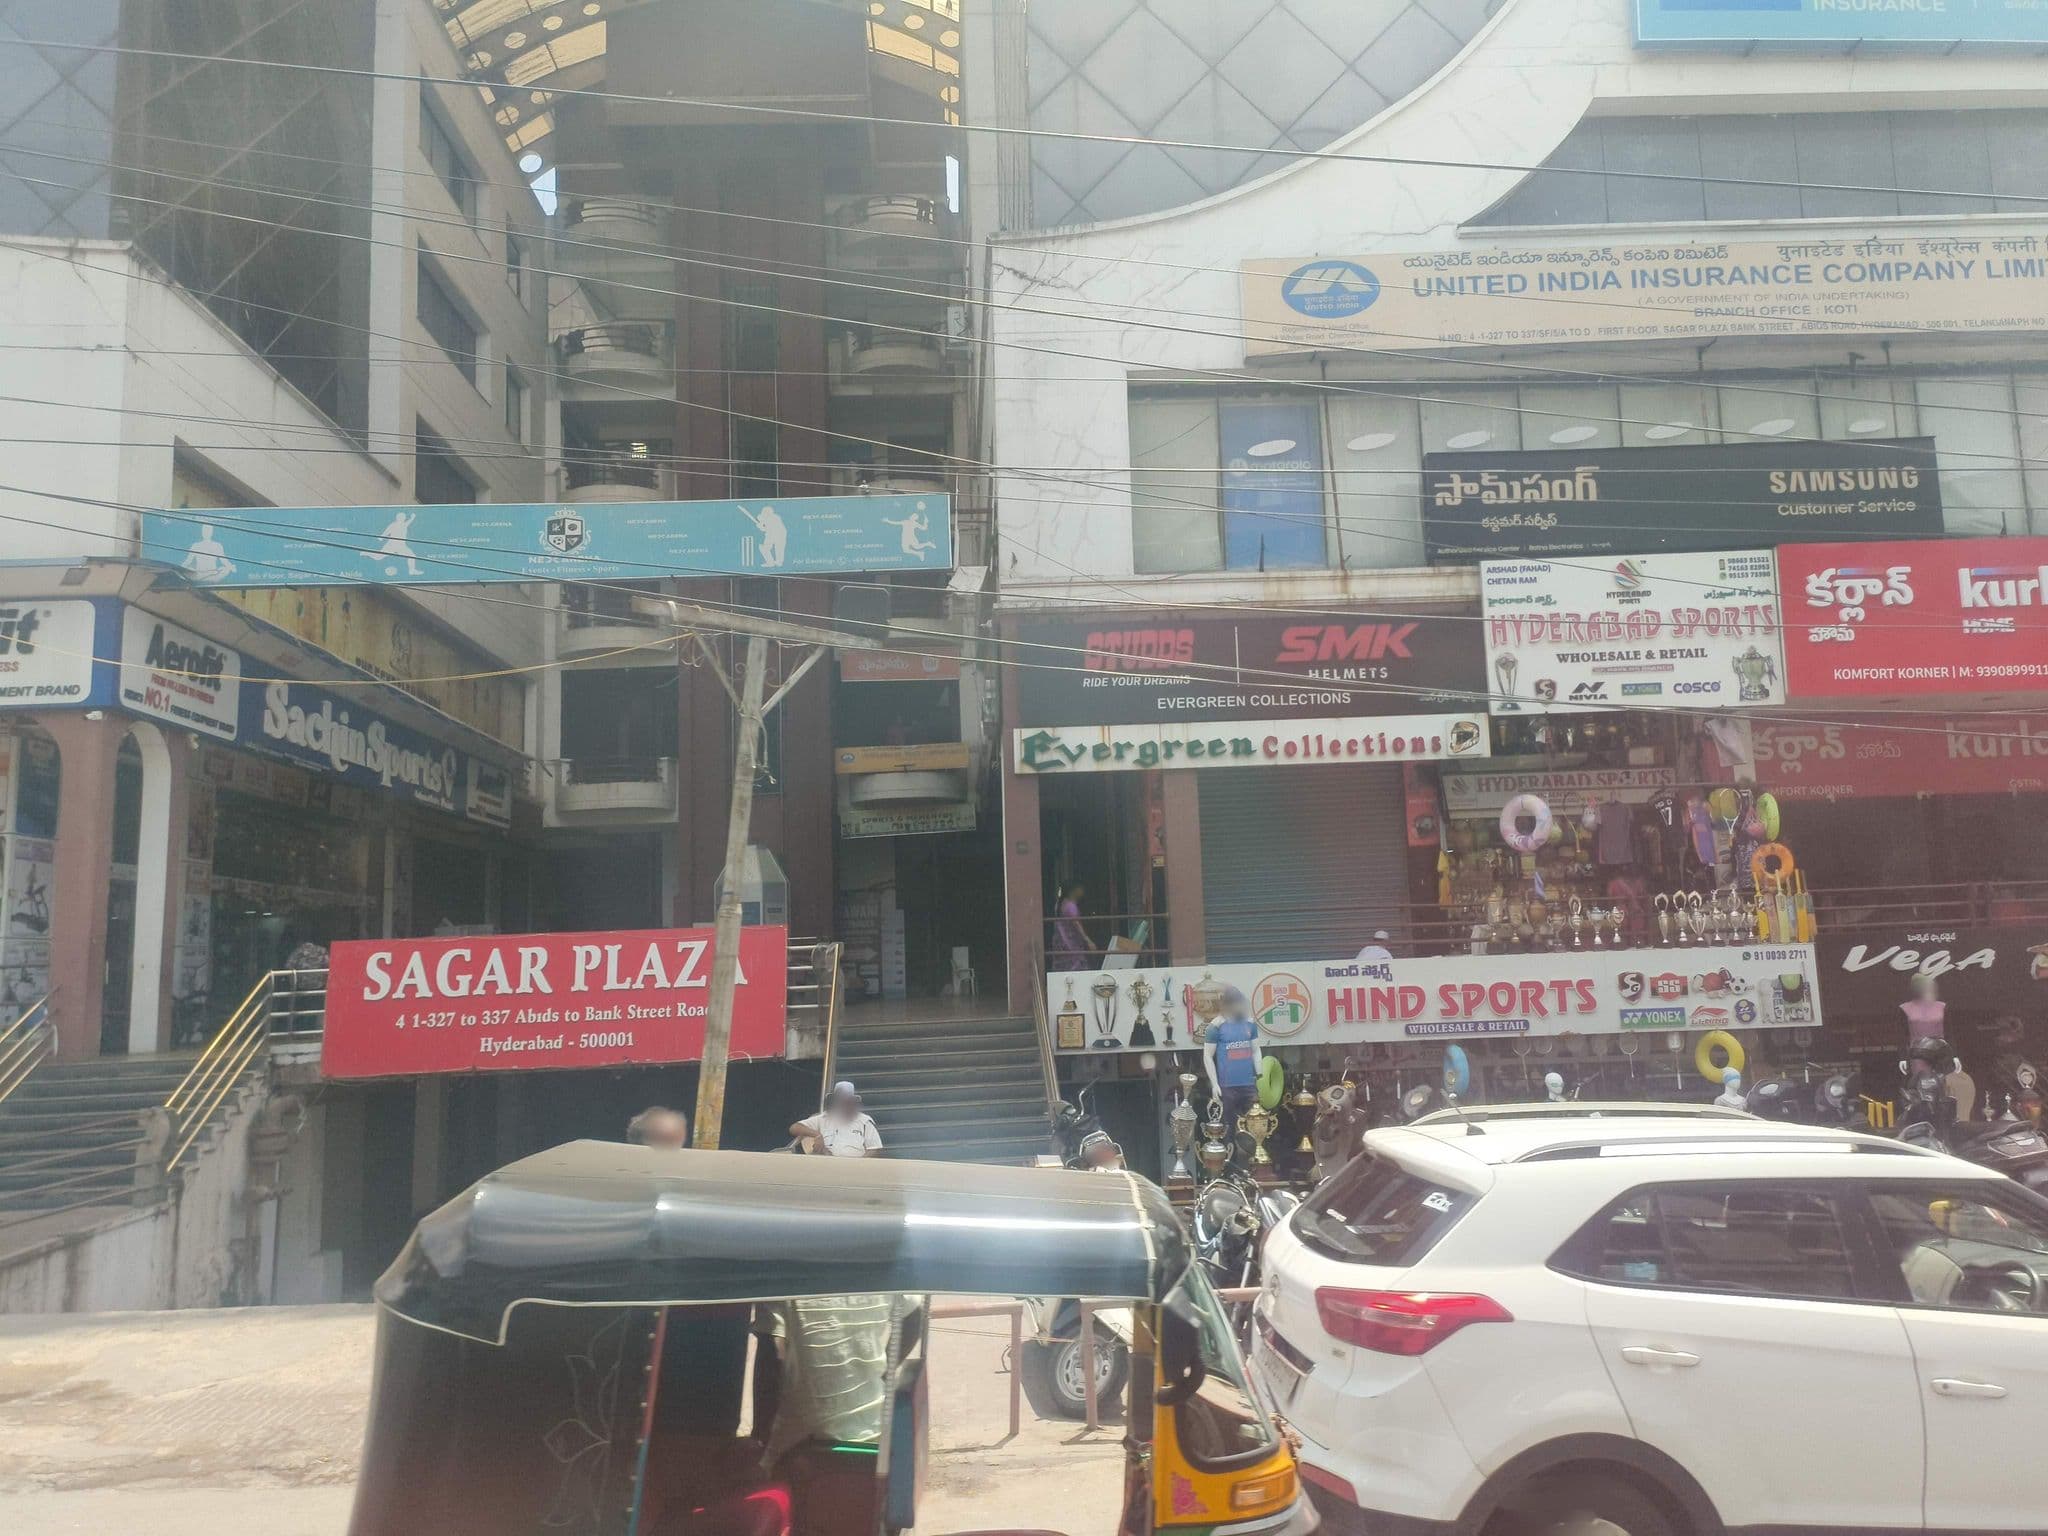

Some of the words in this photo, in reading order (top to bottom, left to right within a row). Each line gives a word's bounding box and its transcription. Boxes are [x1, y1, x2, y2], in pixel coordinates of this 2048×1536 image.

[1413, 274, 1528, 298] UNITED
[1538, 270, 1622, 293] INDIA
[1630, 264, 1813, 289] INSURANCE
[1823, 260, 1976, 284] COMPANY
[1985, 258, 2048, 280] LIMI
[1657, 293, 1749, 305] GOVERNMENT
[1754, 293, 1770, 302] OF
[1776, 291, 1809, 301] INDIA
[1694, 305, 1754, 318] BRANCH
[1760, 304, 1810, 317] OFFICE
[1824, 303, 1857, 315] KOTI
[1598, 326, 1624, 337] FIRST
[1663, 324, 1696, 334] SAGAR
[1697, 324, 1729, 333] PLAZA
[1759, 322, 1793, 332] STREET
[1769, 465, 1919, 494] SAMSUNG
[1778, 502, 1854, 516] Customer
[1858, 498, 1917, 513] Service
[1486, 565, 1518, 574] ARSHAD
[1519, 564, 1551, 574] (FAHAD)
[1487, 577, 1517, 585] CHETAN
[1519, 576, 1537, 584] RAM
[1606, 590, 1652, 599] HYDERABAD
[1489, 609, 1662, 648] HYDERABAD
[1671, 604, 1777, 640] SPORTS
[1962, 617, 2016, 634] HOME
[1085, 629, 1194, 672] STUDDS
[1275, 622, 1422, 663] SMK
[145, 623, 223, 691] Aerofit
[1556, 652, 1641, 664] WHOLESALE
[1645, 650, 1656, 660] &
[1659, 648, 1708, 659] RETAIL
[1082, 677, 1110, 688] RIDE
[1112, 676, 1142, 687] YOUR
[1144, 673, 1191, 687] DREAMS
[1308, 667, 1389, 681] HELMETS
[1834, 668, 1895, 680] KOMFORT
[1898, 666, 1949, 679] KORNER
[1959, 666, 1974, 678] M:
[1976, 664, 2048, 677] 9390899911
[35, 685, 81, 697] BRAND
[144, 686, 170, 712] NO.1
[1568, 693, 1608, 701] NIVIA
[1673, 682, 1720, 694] COSCO
[1157, 694, 1246, 710] EVERGREEN
[1249, 692, 1351, 707] COLLECTIONS
[263, 682, 366, 772] Sachin
[366, 719, 441, 793] Sports
[1020, 730, 1257, 772] Evergreen
[1262, 732, 1442, 759] Collections
[1478, 773, 1593, 792] HYDERABAD
[363, 945, 552, 1001] SAGAR
[571, 939, 748, 994] PLAZ
[1657, 979, 1681, 994] SS
[1327, 985, 1426, 1026] HIND
[1438, 978, 1599, 1019] SPORTS
[411, 1012, 456, 1029] 1-327
[460, 1013, 477, 1027] to
[481, 1010, 509, 1025] 337
[564, 1008, 580, 1022] to
[585, 1005, 623, 1022] Bank
[627, 1003, 672, 1020] Street
[1646, 1010, 1681, 1023] YONEX
[1408, 1022, 1476, 1034] WHOLESALE
[1478, 1022, 1486, 1032] &
[1488, 1021, 1527, 1031] RETAIL
[479, 1033, 564, 1057] Hyderabad
[579, 1031, 635, 1050] 500001
